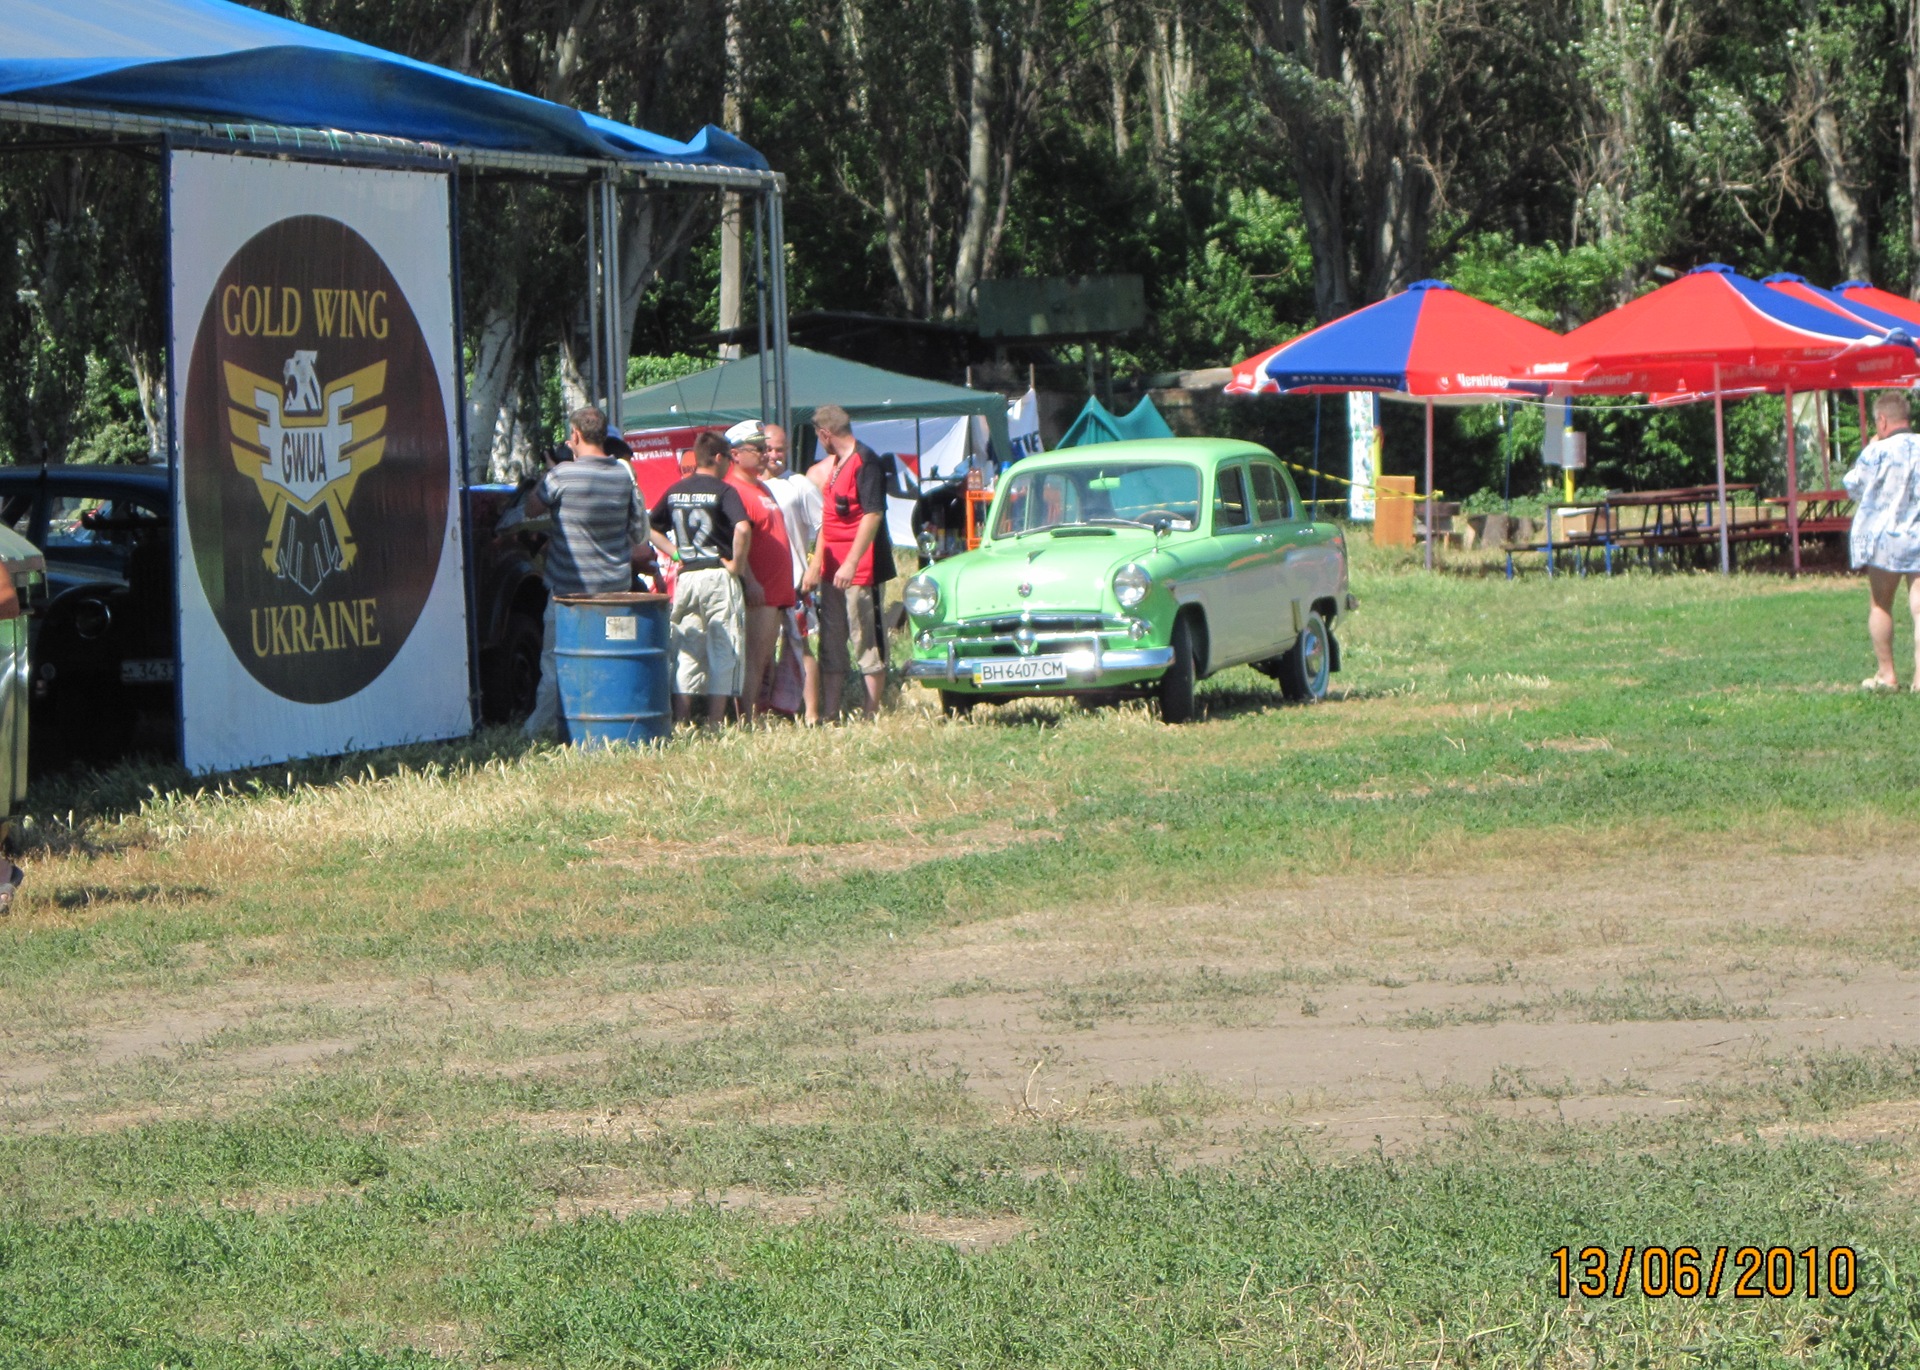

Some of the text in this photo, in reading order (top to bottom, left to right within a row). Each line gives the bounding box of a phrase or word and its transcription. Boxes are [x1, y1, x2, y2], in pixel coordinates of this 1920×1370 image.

[222, 284, 388, 339] GOLD WING
[281, 431, 328, 484] GWUA
[631, 450, 673, 461] ТЕРИАЛЫ
[691, 493, 717, 503] SHOW
[671, 508, 719, 558] 12
[250, 598, 381, 658] UKRAINE
[982, 665, 1004, 680] BH
[1006, 662, 1038, 678] 6407
